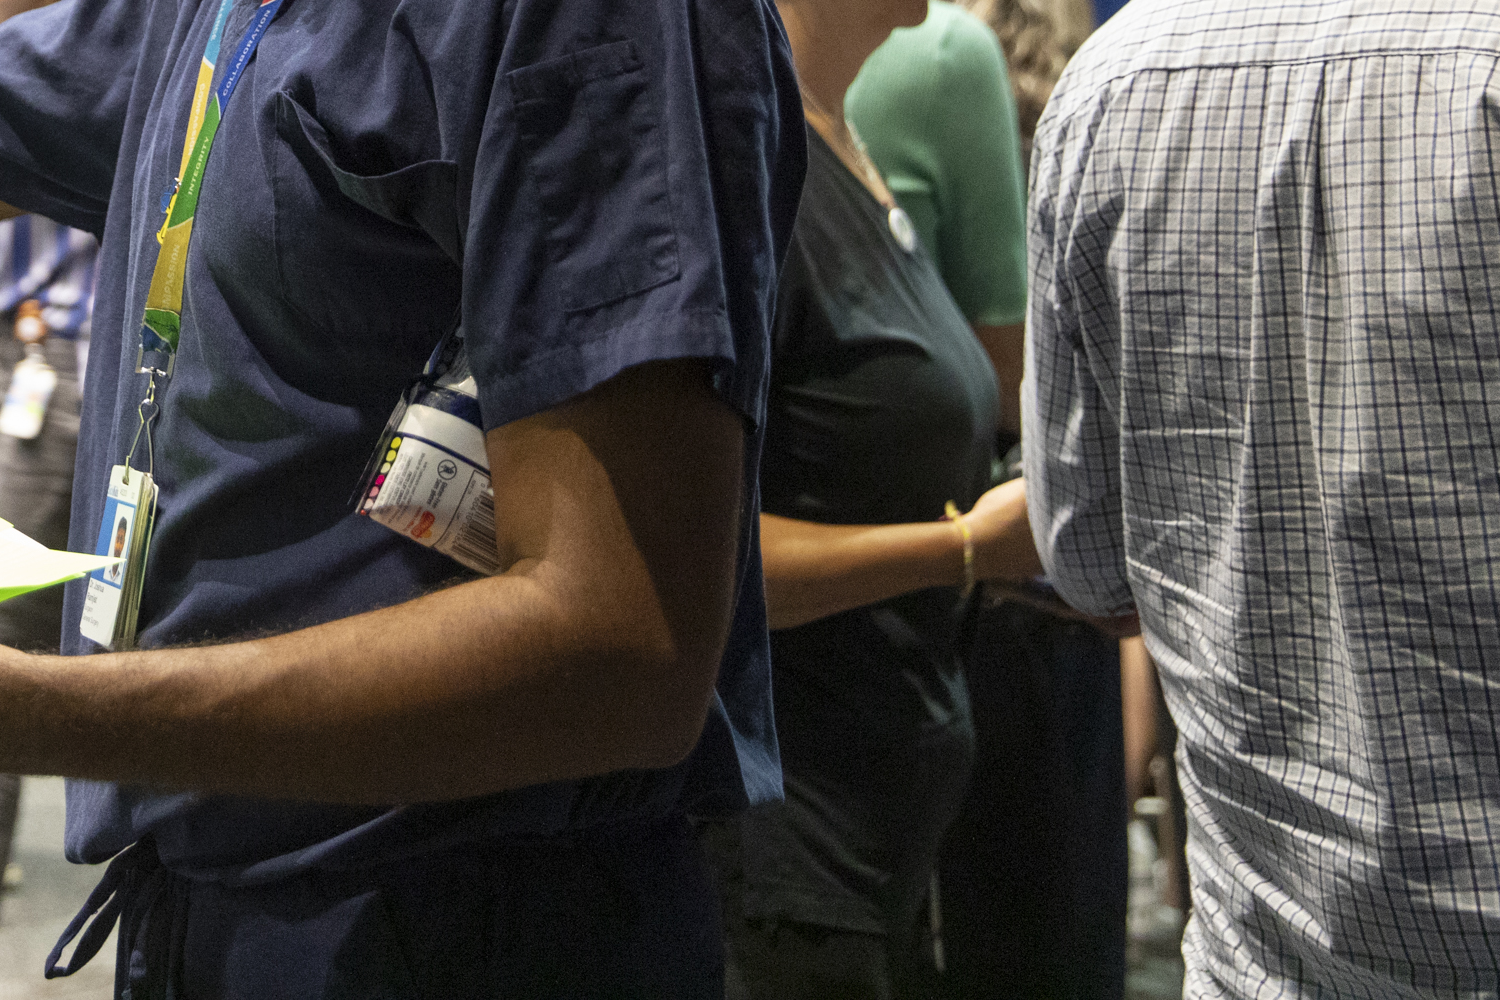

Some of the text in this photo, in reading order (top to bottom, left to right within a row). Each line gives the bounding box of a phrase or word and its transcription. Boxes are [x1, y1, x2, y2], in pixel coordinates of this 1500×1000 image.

[222, 9, 271, 97] COLLABORATION
[187, 136, 211, 196] INTEGRITY
[162, 243, 181, 309] MPASSION
